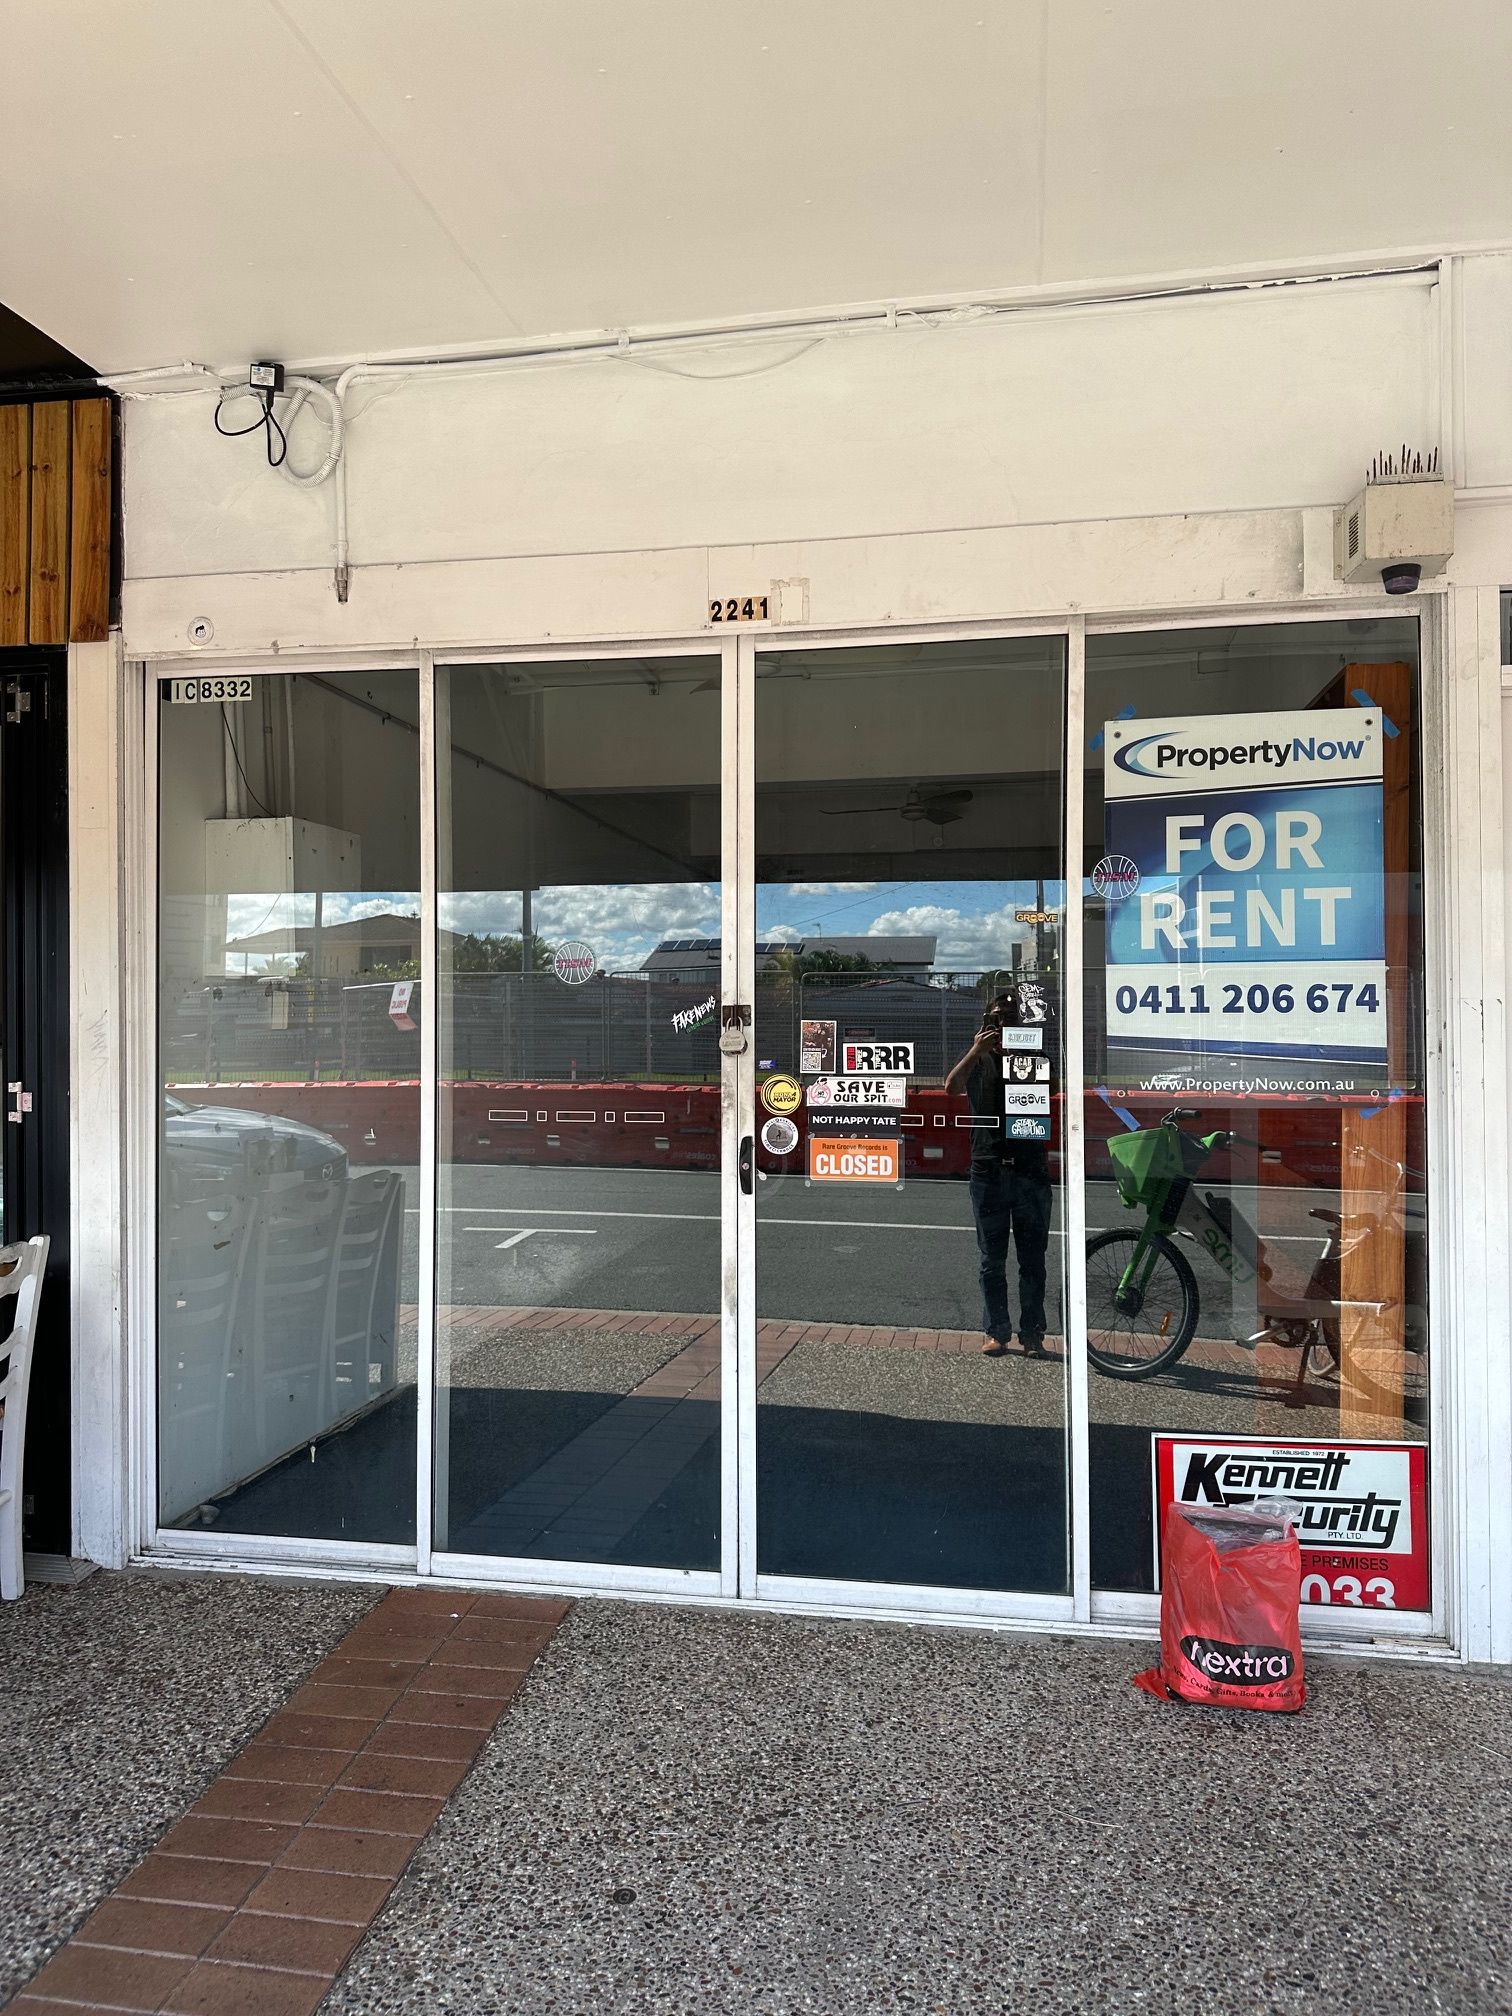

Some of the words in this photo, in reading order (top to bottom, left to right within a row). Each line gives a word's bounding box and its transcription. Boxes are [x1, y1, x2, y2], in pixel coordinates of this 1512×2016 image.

[710, 598, 758, 622] 2241
[1156, 737, 1365, 770] PropertyNow
[1165, 810, 1325, 873] FOR
[1016, 912, 1058, 924] GROOVE
[1139, 886, 1352, 950] RENT
[1115, 985, 1210, 1015] 0411
[1222, 984, 1295, 1014] 206
[1305, 984, 1380, 1014] 674
[836, 1081, 886, 1094] SAVE
[1140, 1078, 1354, 1095] www.PropertyNow.com.au
[833, 1093, 858, 1103] OUR
[1008, 1094, 1047, 1107] GROOVE
[812, 1115, 834, 1124] NOT
[835, 1116, 871, 1125] HAPPY
[872, 1117, 897, 1126] TATE
[836, 1143, 857, 1151] Groove
[815, 1154, 893, 1176] CLOSED
[1181, 1451, 1350, 1503] Kennett
[1232, 1492, 1402, 1549] urity
[1328, 1531, 1344, 1539] PTY.
[1346, 1532, 1364, 1540] LTD.
[1312, 1554, 1389, 1571] PREMISES
[1216, 1687, 1239, 1697] Gifts,
[1240, 1690, 1265, 1698] Books
